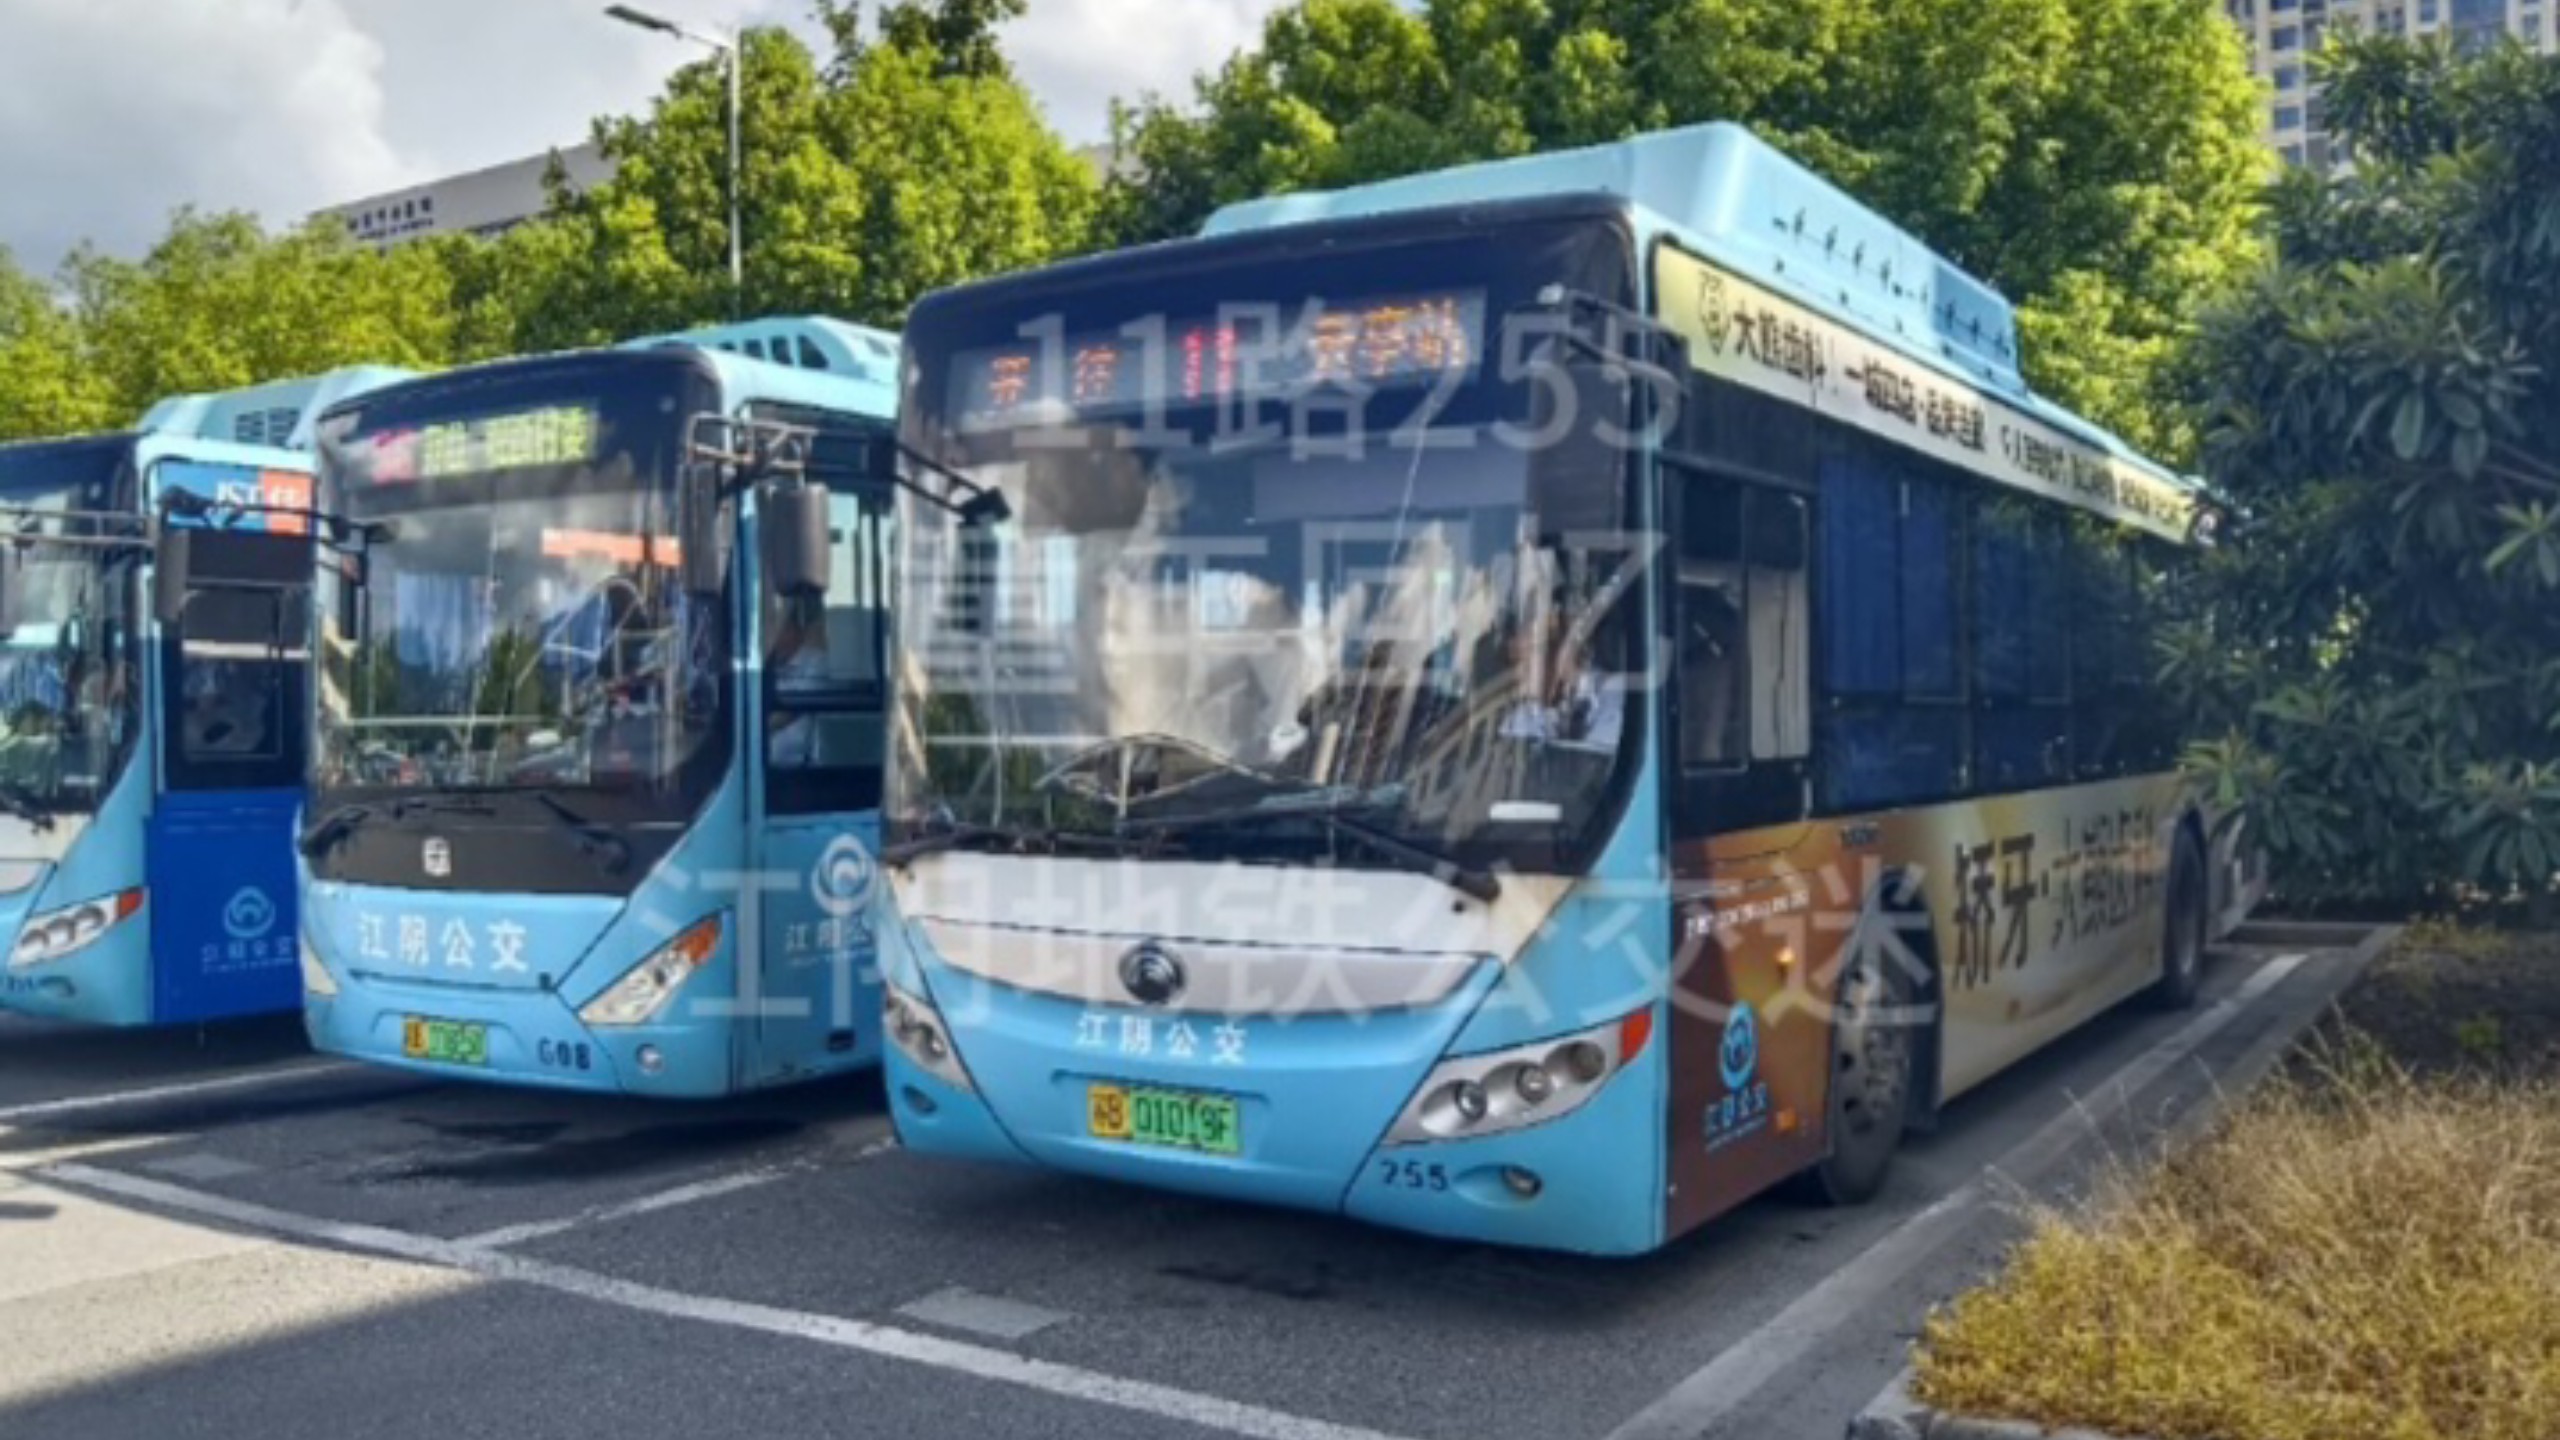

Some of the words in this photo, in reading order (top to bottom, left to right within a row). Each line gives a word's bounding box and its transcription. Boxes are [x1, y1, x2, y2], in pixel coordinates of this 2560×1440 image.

[360, 911, 528, 973] 江阴公交
[1075, 1012, 1248, 1064] 江阴公交
[1379, 1158, 1449, 1191] 255
